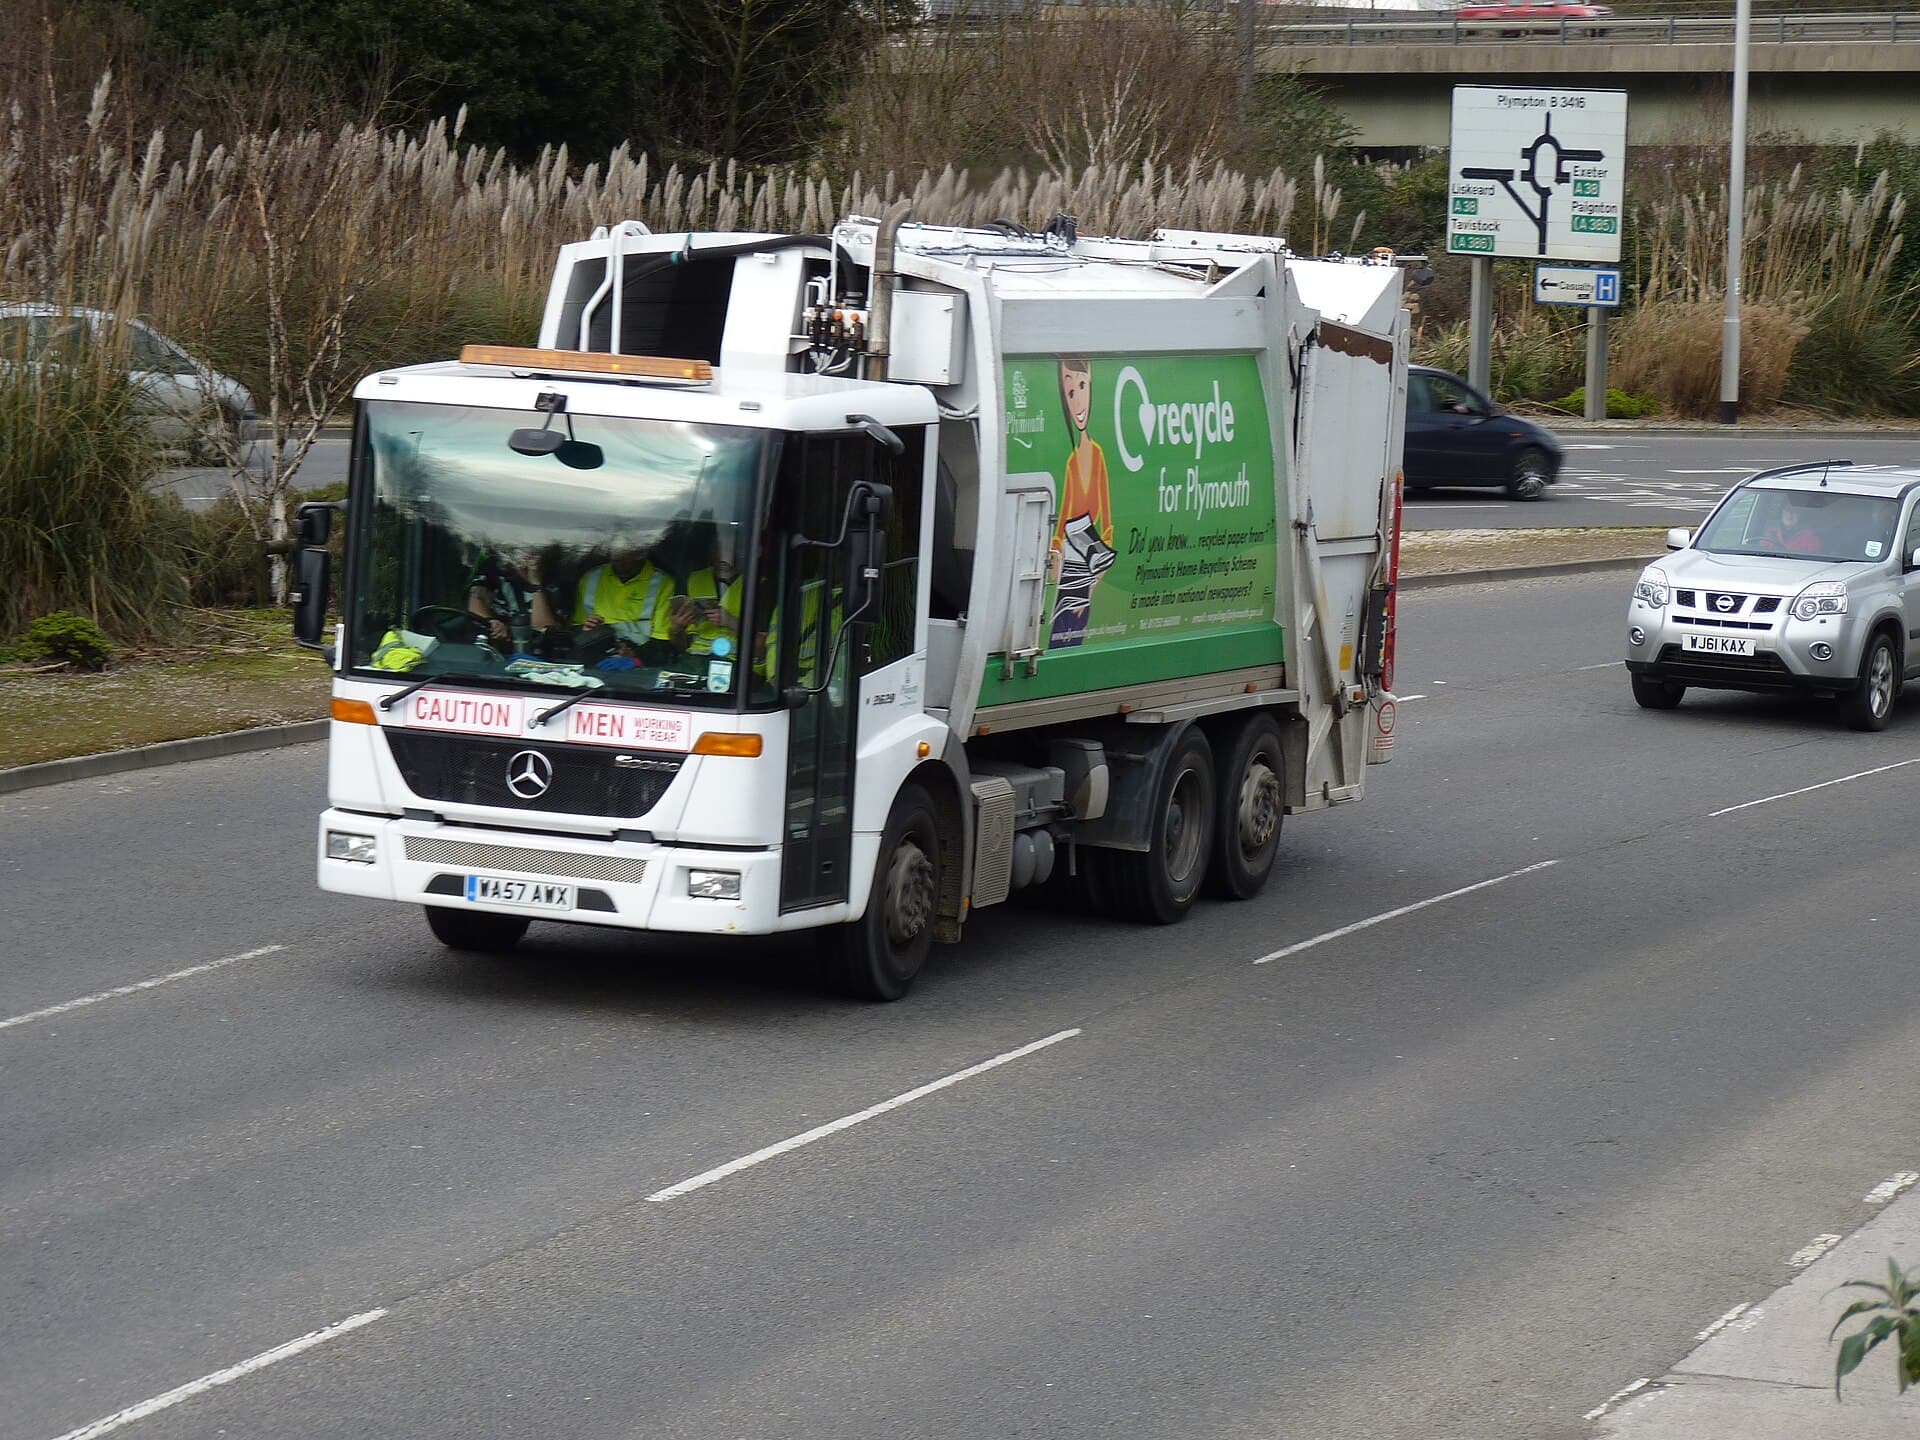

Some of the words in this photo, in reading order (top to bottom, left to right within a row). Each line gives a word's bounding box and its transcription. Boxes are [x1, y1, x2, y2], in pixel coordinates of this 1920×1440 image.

[1497, 95, 1546, 108] Plympton
[1550, 96, 1557, 107] B
[1560, 96, 1585, 108] 3416
[1573, 165, 1608, 178] Exeter
[1452, 183, 1495, 196] Liskeard
[1575, 182, 1583, 194] A
[1584, 182, 1598, 195] 38
[1454, 200, 1462, 212] A
[1463, 200, 1476, 213] 38
[1572, 201, 1617, 215] Paignton
[1451, 218, 1501, 232] Tavistock
[1559, 281, 1594, 293] Casualty
[1599, 278, 1613, 300] H
[1157, 380, 1235, 459] recycle
[1159, 466, 1182, 513] for
[1186, 462, 1250, 520] Plymouth
[1128, 526, 1149, 555] Did
[1147, 535, 1165, 563] you
[1199, 528, 1228, 551] recycled
[1227, 532, 1248, 549] paper
[1249, 527, 1265, 543] from
[1135, 561, 1176, 585] Plymouth's
[1177, 560, 1198, 577] Home
[1198, 558, 1231, 578] Recycling
[1231, 555, 1257, 572] Scheme
[1130, 593, 1138, 609] is
[1138, 590, 1160, 609] made
[1160, 590, 1176, 606] into
[1176, 585, 1209, 604] national
[1690, 636, 1718, 651] WJ61
[1721, 639, 1746, 653] KAX
[416, 696, 511, 727] CAUTION
[575, 711, 625, 738] MEN
[634, 717, 682, 732] WORKING
[635, 729, 647, 740] AT
[650, 730, 677, 743] REAR
[480, 879, 527, 901] WA57
[531, 885, 569, 905] AWX
